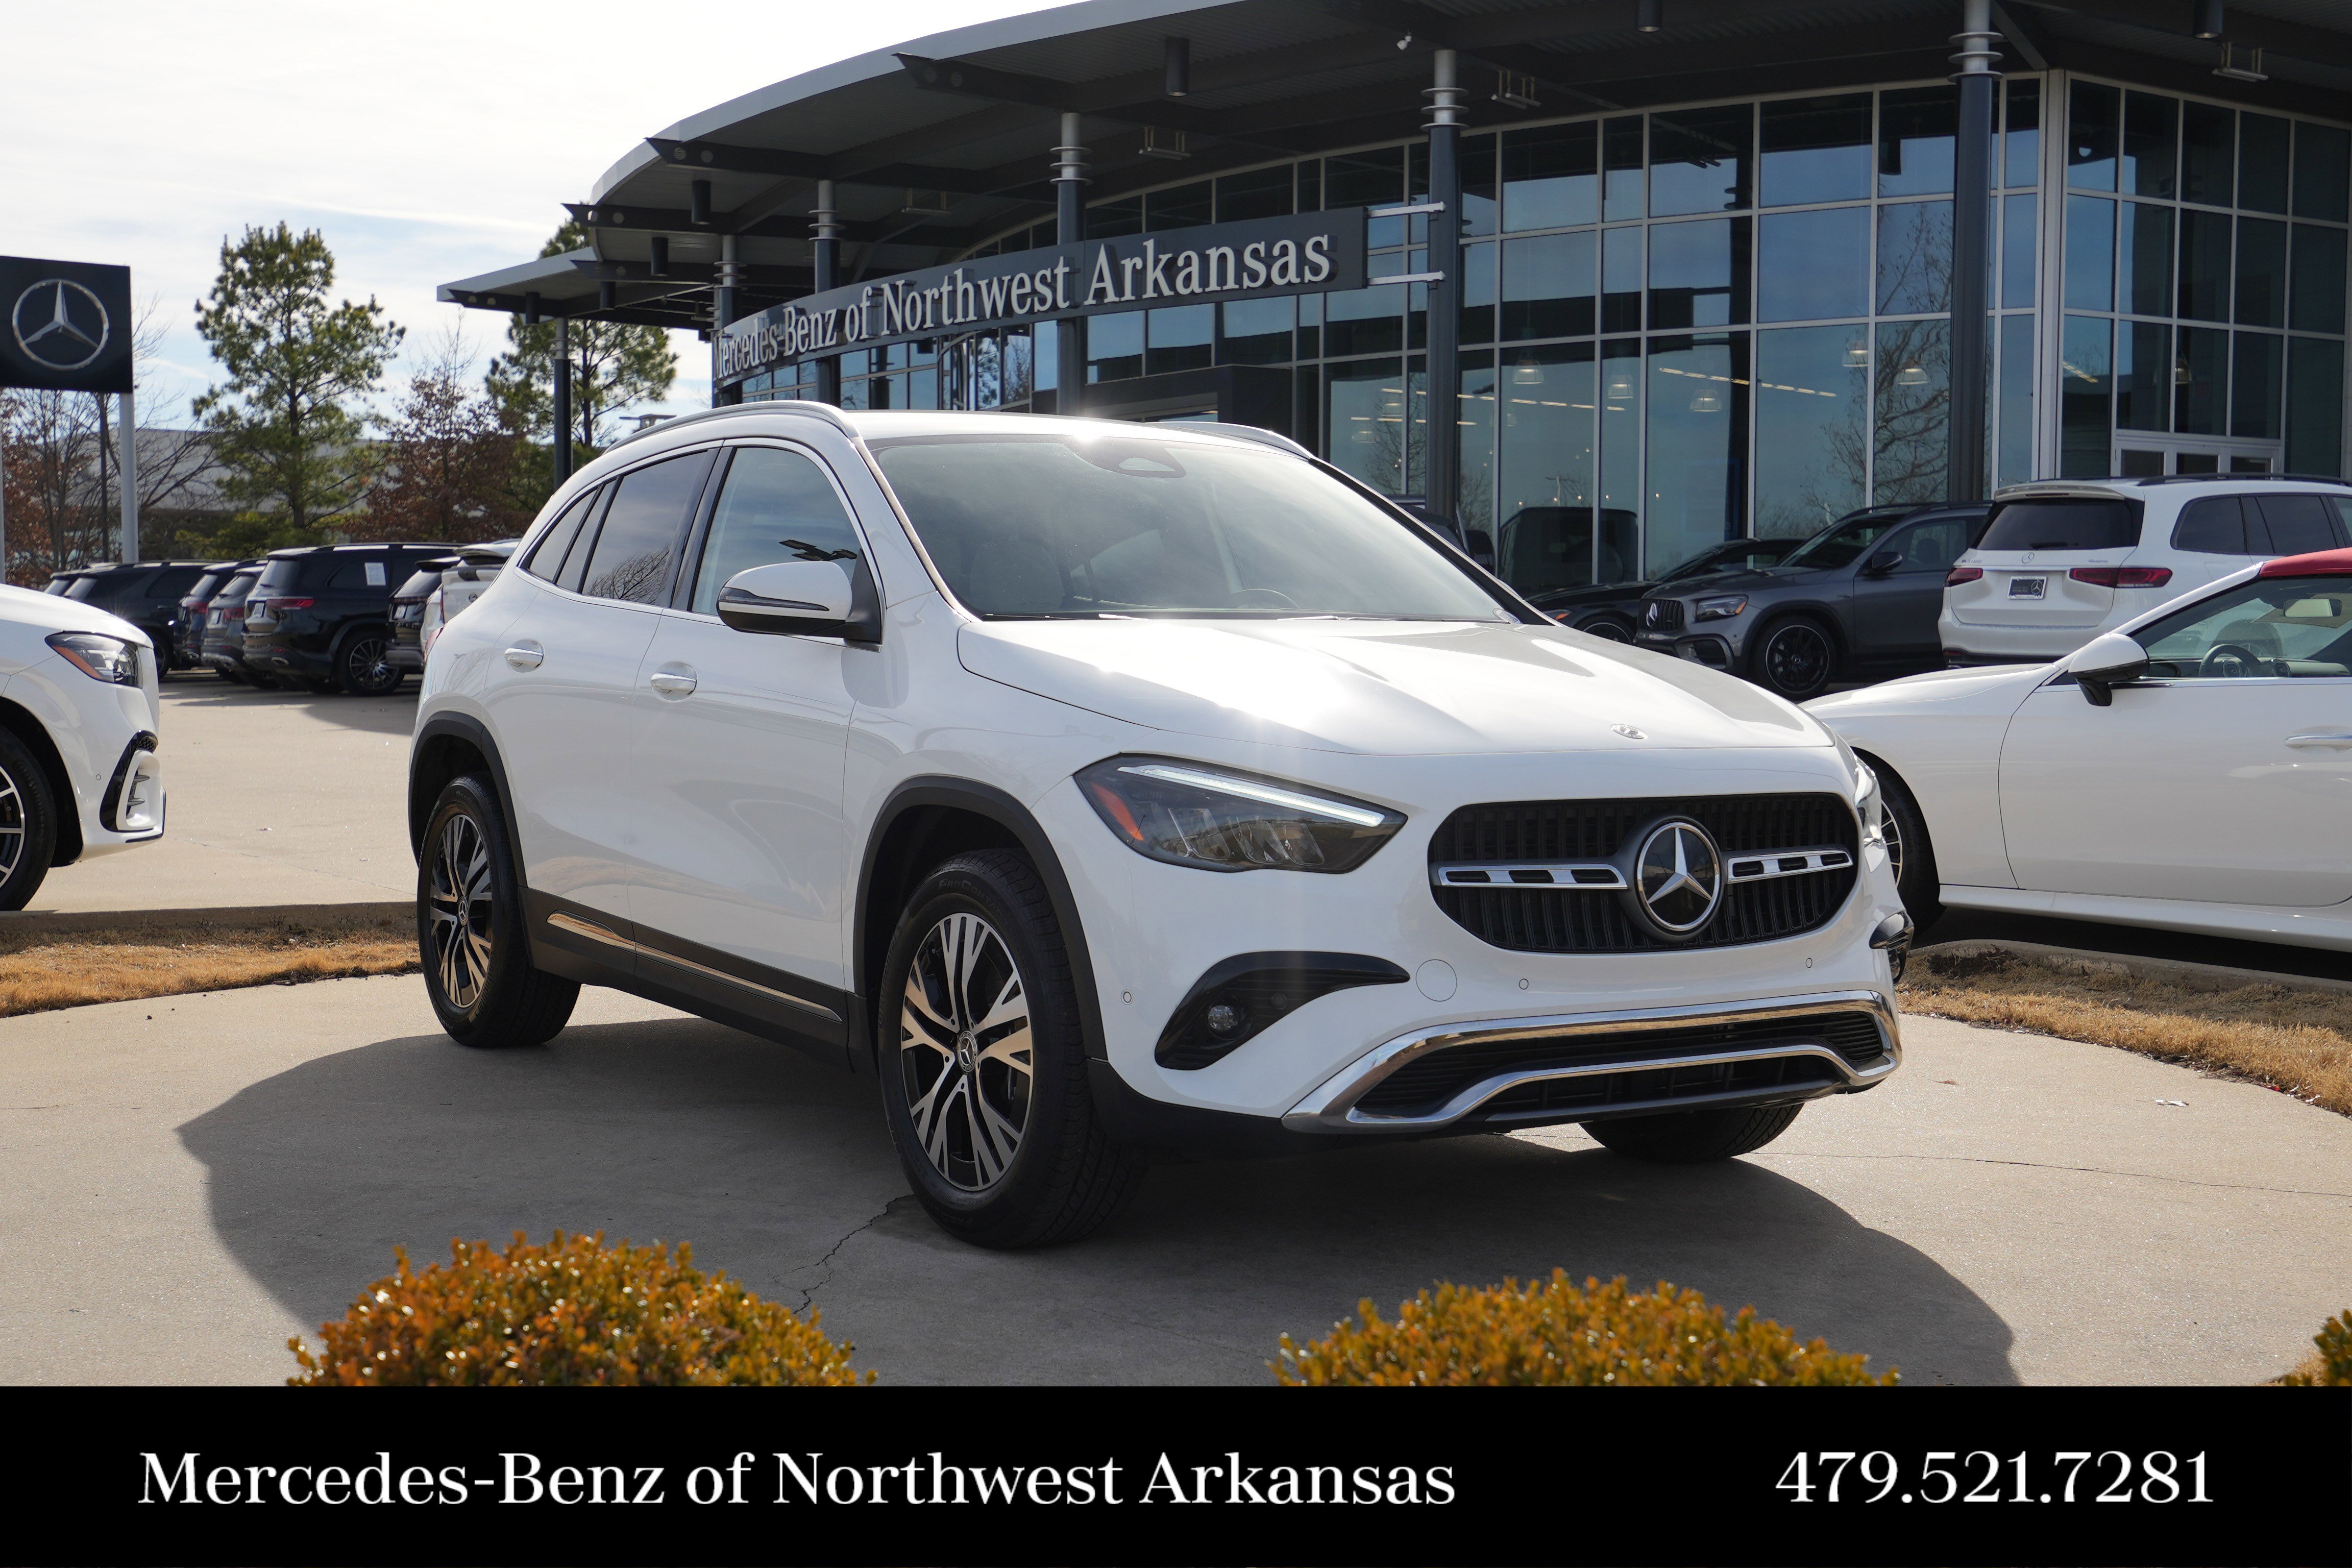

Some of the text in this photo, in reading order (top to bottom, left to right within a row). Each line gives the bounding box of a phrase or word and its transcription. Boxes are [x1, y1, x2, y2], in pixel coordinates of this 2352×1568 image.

[713, 234, 1329, 380] Mercedes-Benz of Northwest Arkansas
